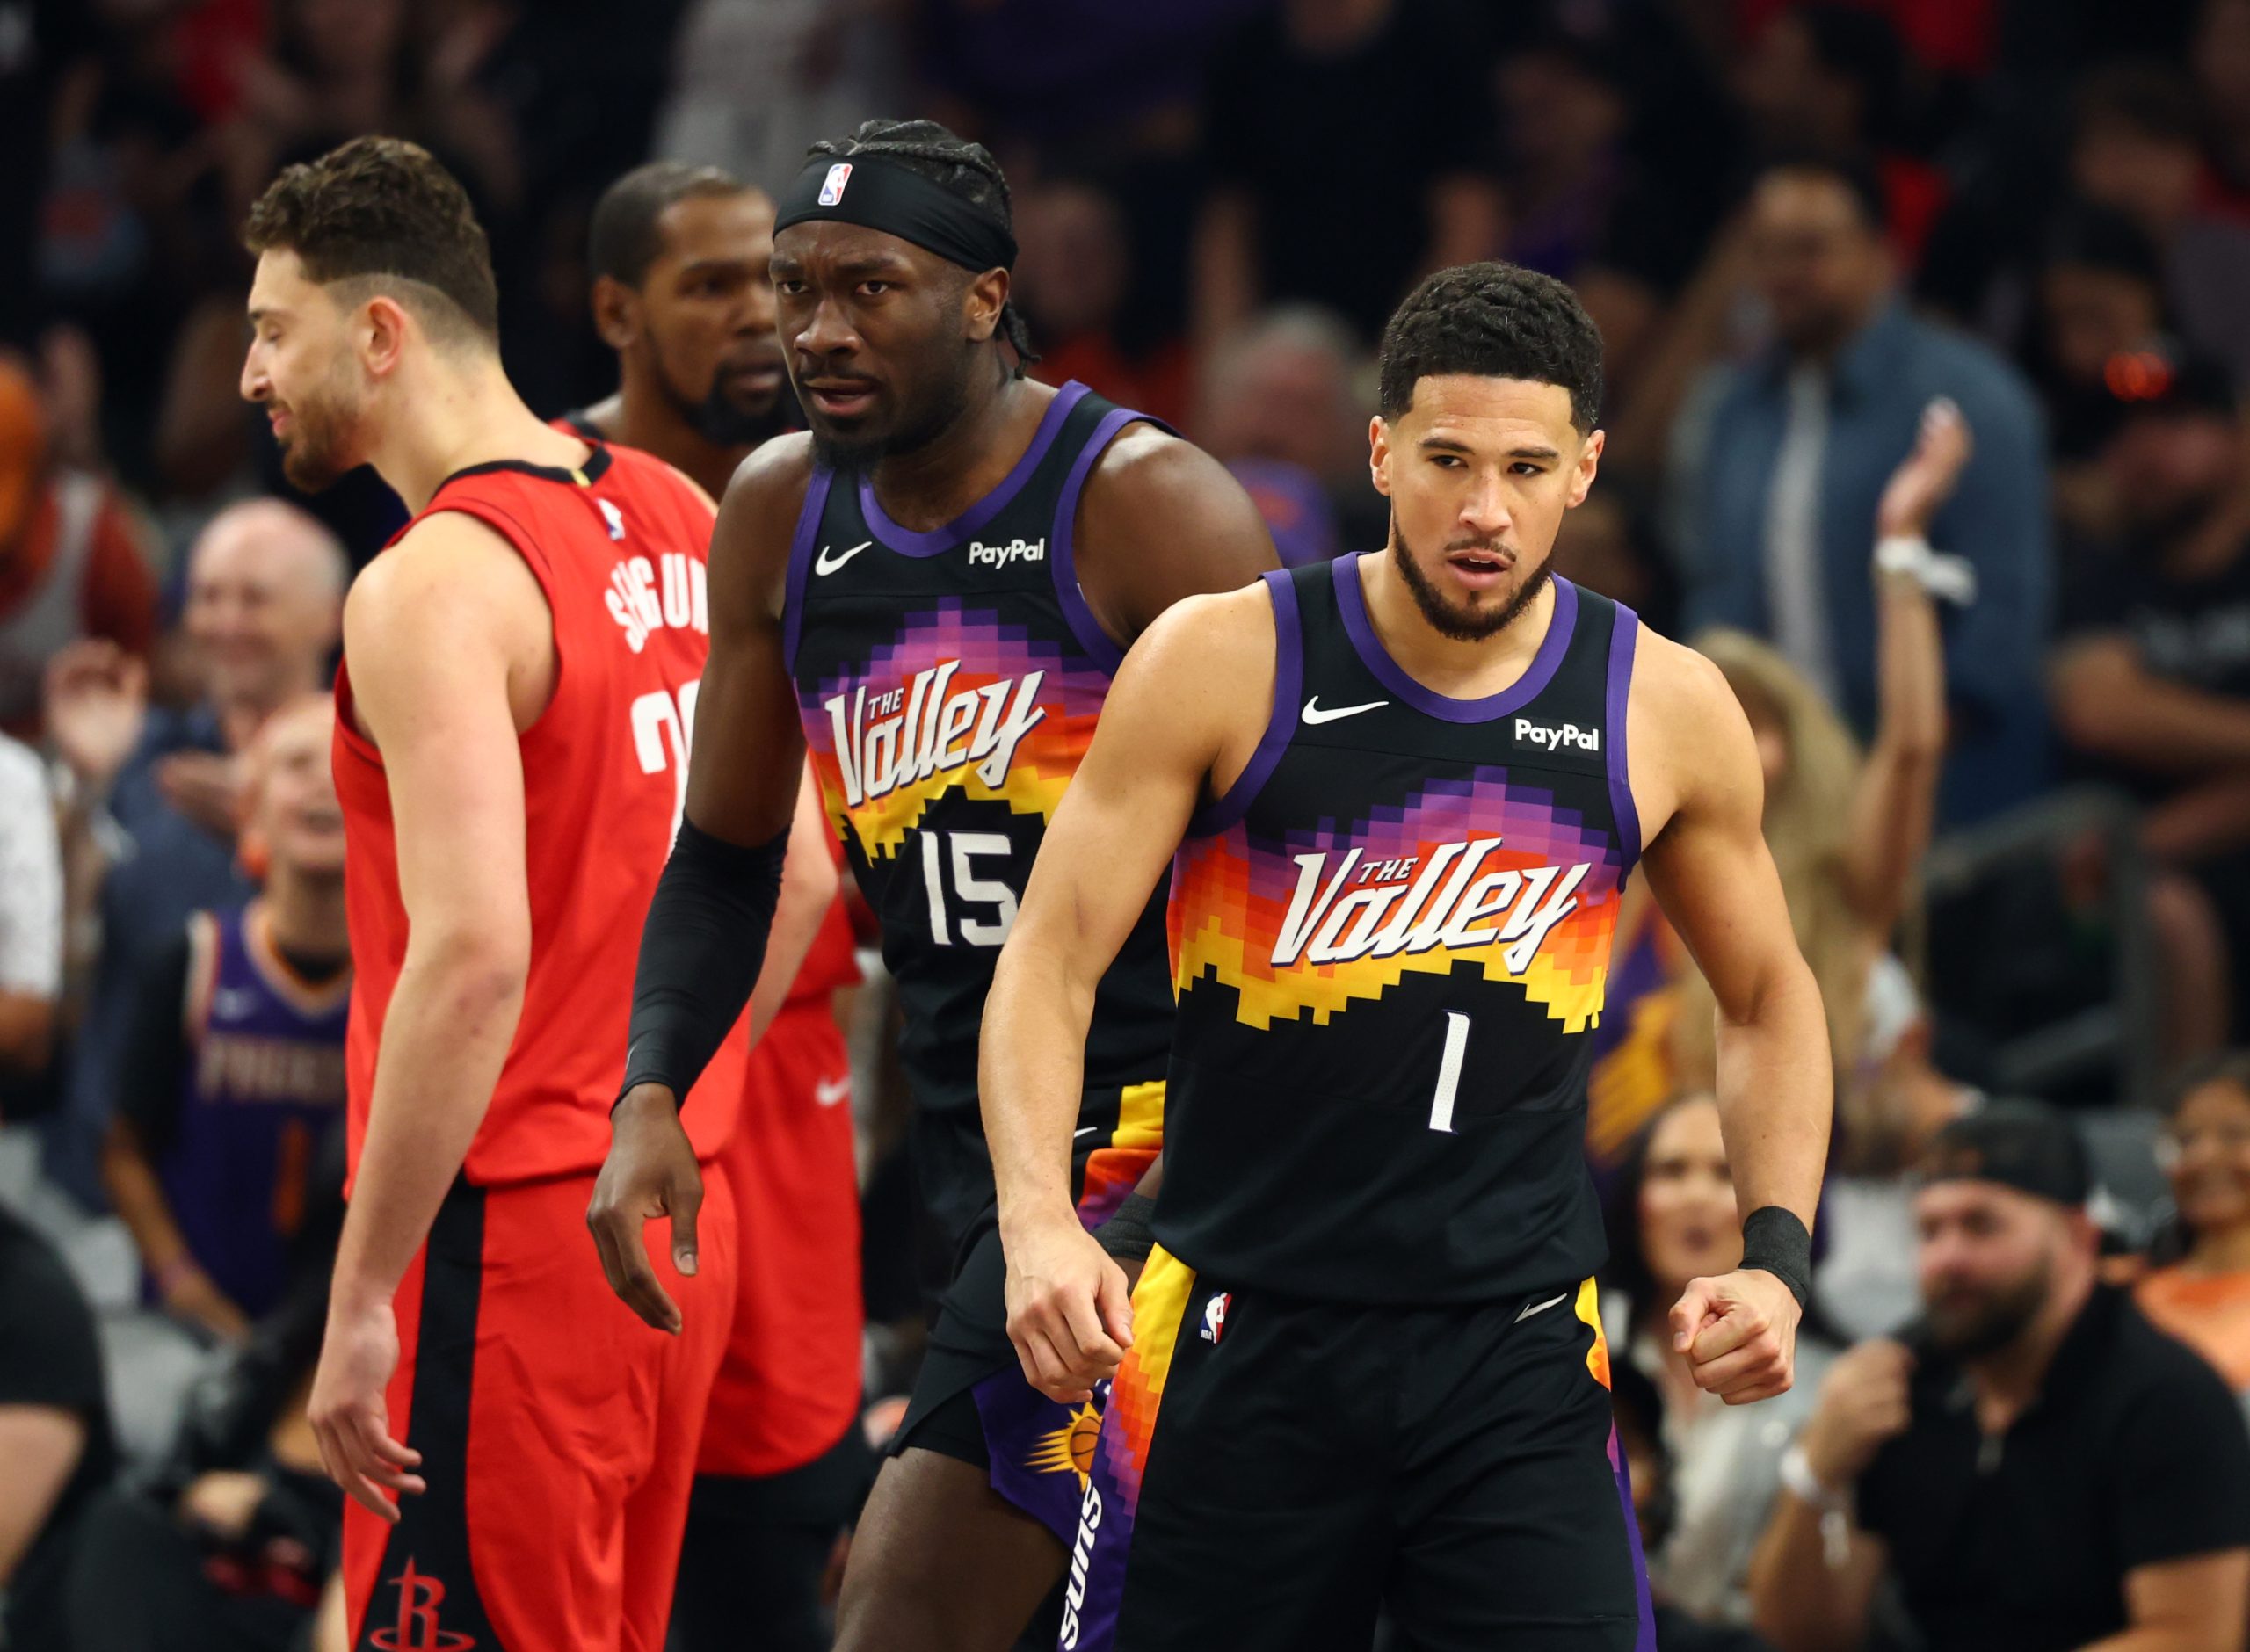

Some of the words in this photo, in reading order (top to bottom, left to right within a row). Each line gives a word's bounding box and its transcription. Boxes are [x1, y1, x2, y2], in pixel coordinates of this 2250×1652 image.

[969, 538, 1045, 569] PayPal
[824, 659, 1048, 809] Valley
[868, 687, 904, 720] THE
[1515, 718, 1599, 751] PayPal
[919, 830, 1019, 946] 15
[1271, 837, 1591, 976] Valley
[1358, 858, 1419, 884] THE
[1428, 1011, 1470, 1133] 1
